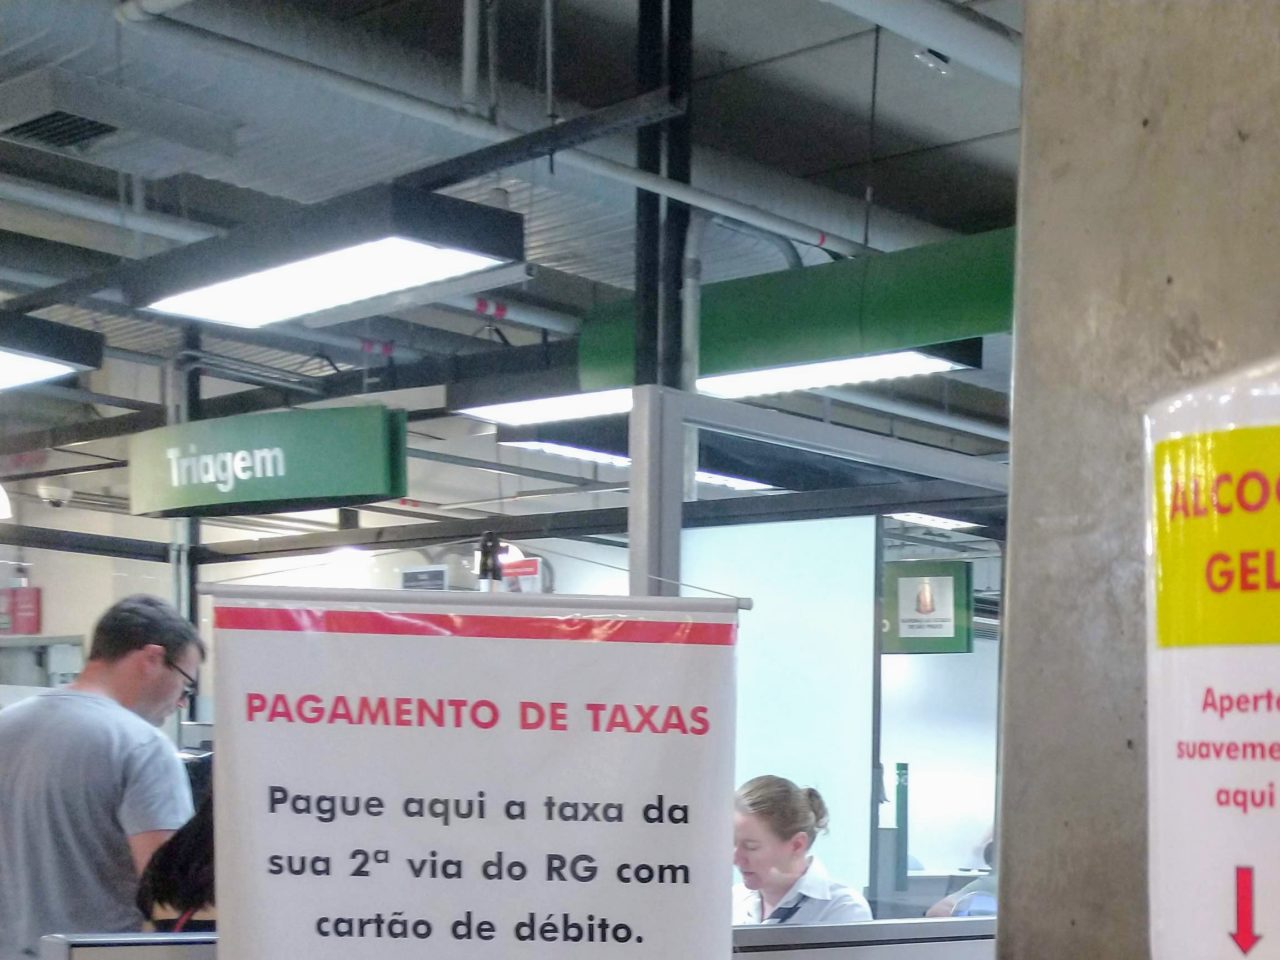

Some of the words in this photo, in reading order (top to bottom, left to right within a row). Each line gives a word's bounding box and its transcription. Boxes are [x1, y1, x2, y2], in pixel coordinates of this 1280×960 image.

[165, 443, 286, 493] Triagem
[245, 692, 500, 731] PAGAMENTO
[518, 700, 569, 732] DE
[585, 702, 712, 737] TAXAS
[267, 785, 386, 823] Pague
[402, 789, 487, 828] aqui
[503, 799, 527, 822] a
[543, 794, 625, 824] taxa
[642, 794, 690, 825] da
[1215, 783, 1276, 814] aqui
[267, 853, 332, 878] sua
[348, 847, 391, 878] 2ª
[406, 849, 463, 880] via
[481, 850, 528, 882] do
[545, 853, 599, 883] RG
[615, 862, 691, 885] com
[314, 910, 434, 941] cartão
[450, 910, 497, 942] de
[513, 911, 645, 944] débito.
